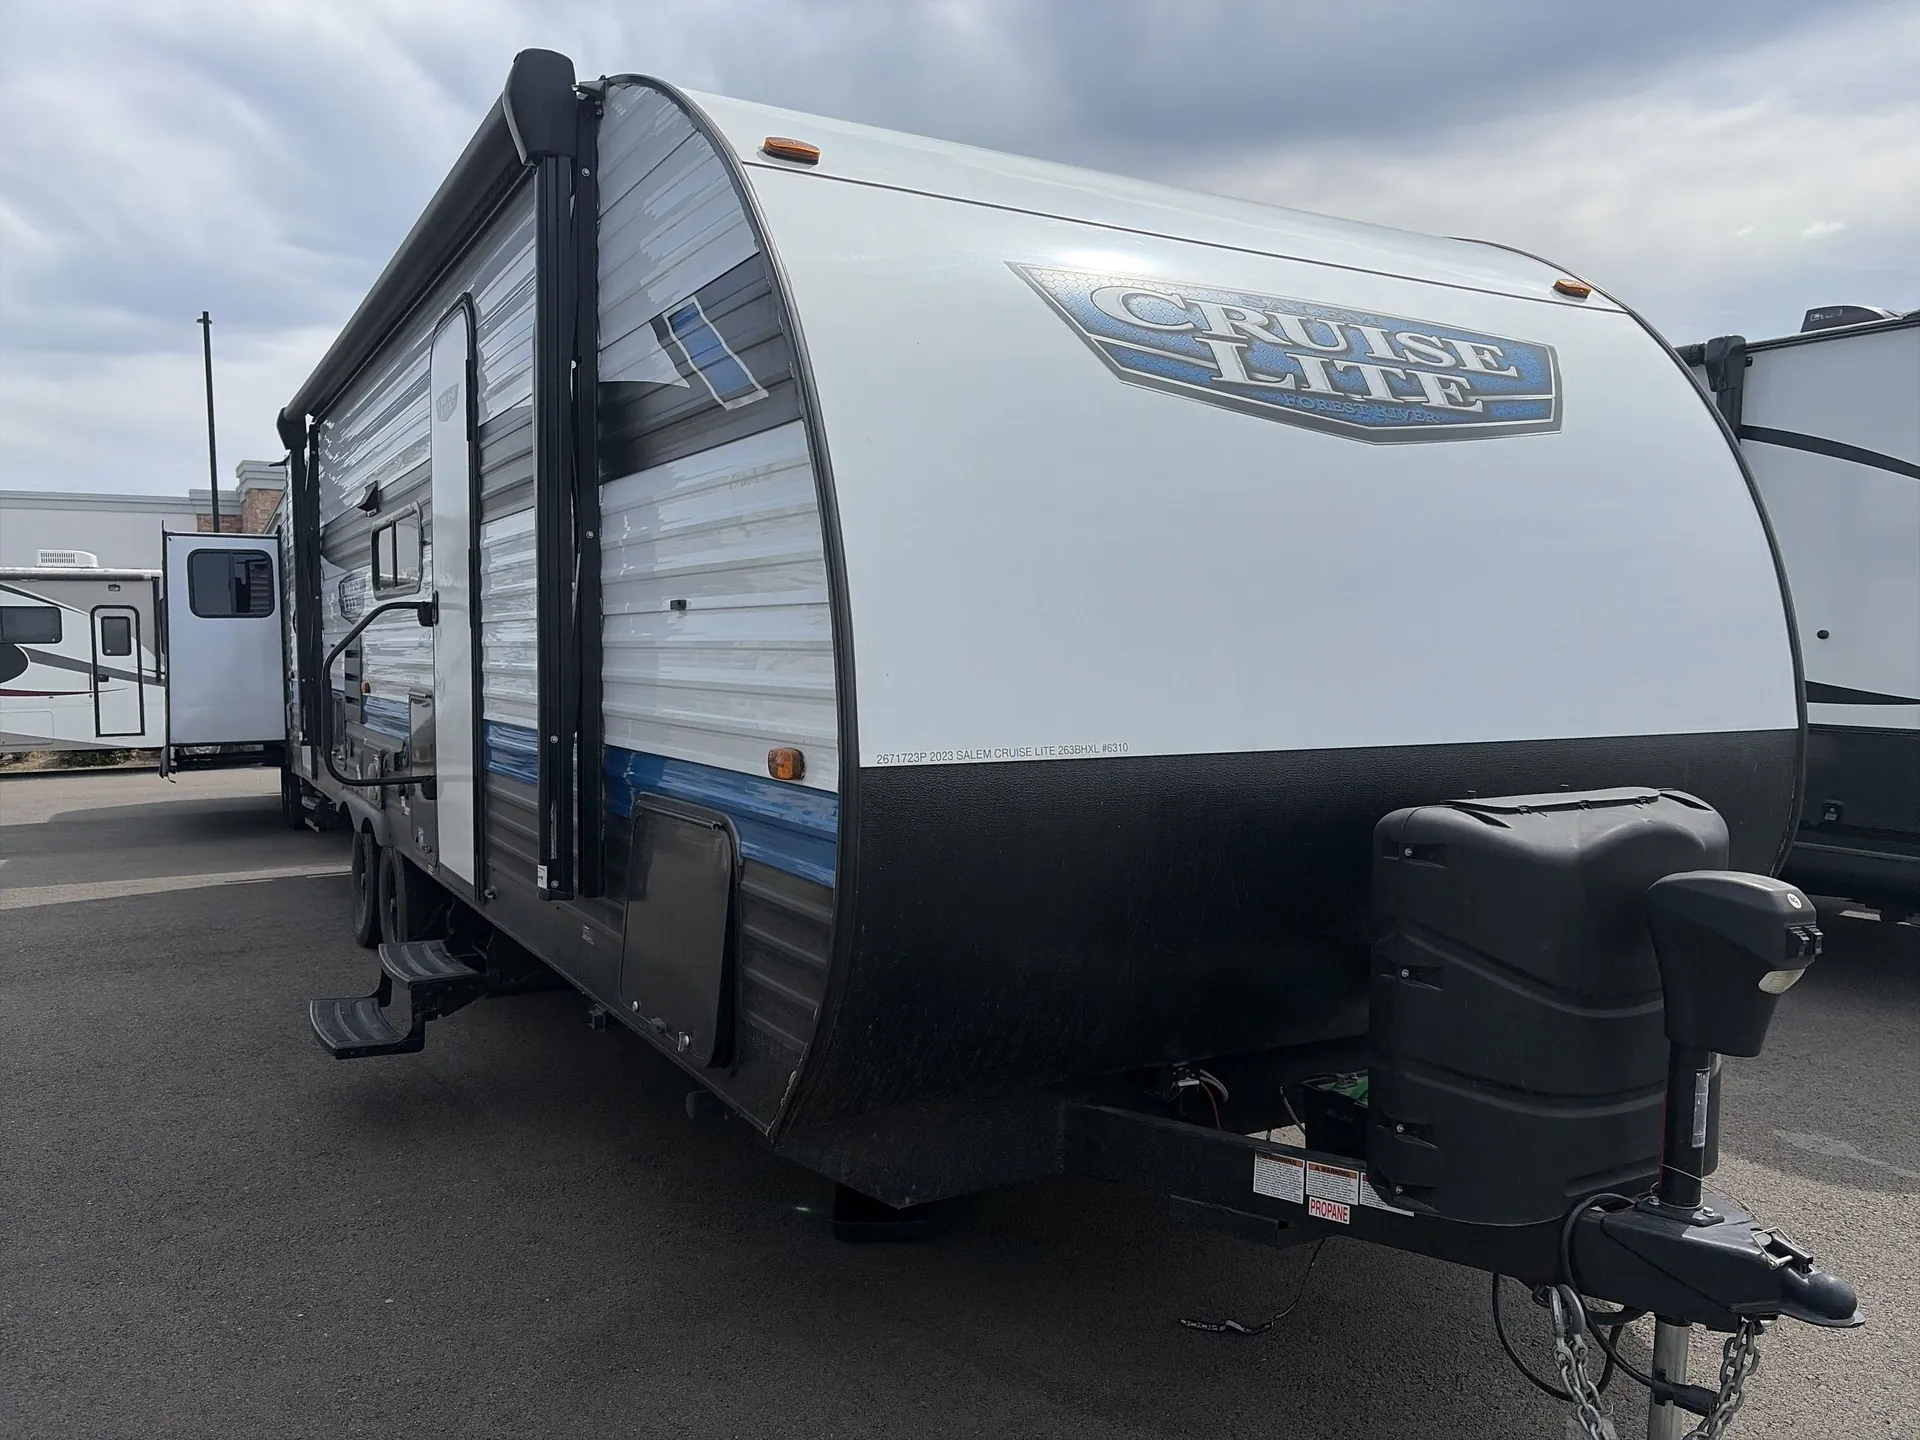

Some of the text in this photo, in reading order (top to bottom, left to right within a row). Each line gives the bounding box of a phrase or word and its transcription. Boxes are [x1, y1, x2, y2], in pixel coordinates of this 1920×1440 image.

[1090, 285, 1518, 378] CRUISE
[1194, 337, 1484, 413] LITE
[1283, 392, 1442, 424] FOREST RIVER
[876, 742, 1129, 765] 2671723P 2023 SALEM CRUISE LITE 263BHXL #6310
[1310, 1200, 1348, 1223] PROPANE
